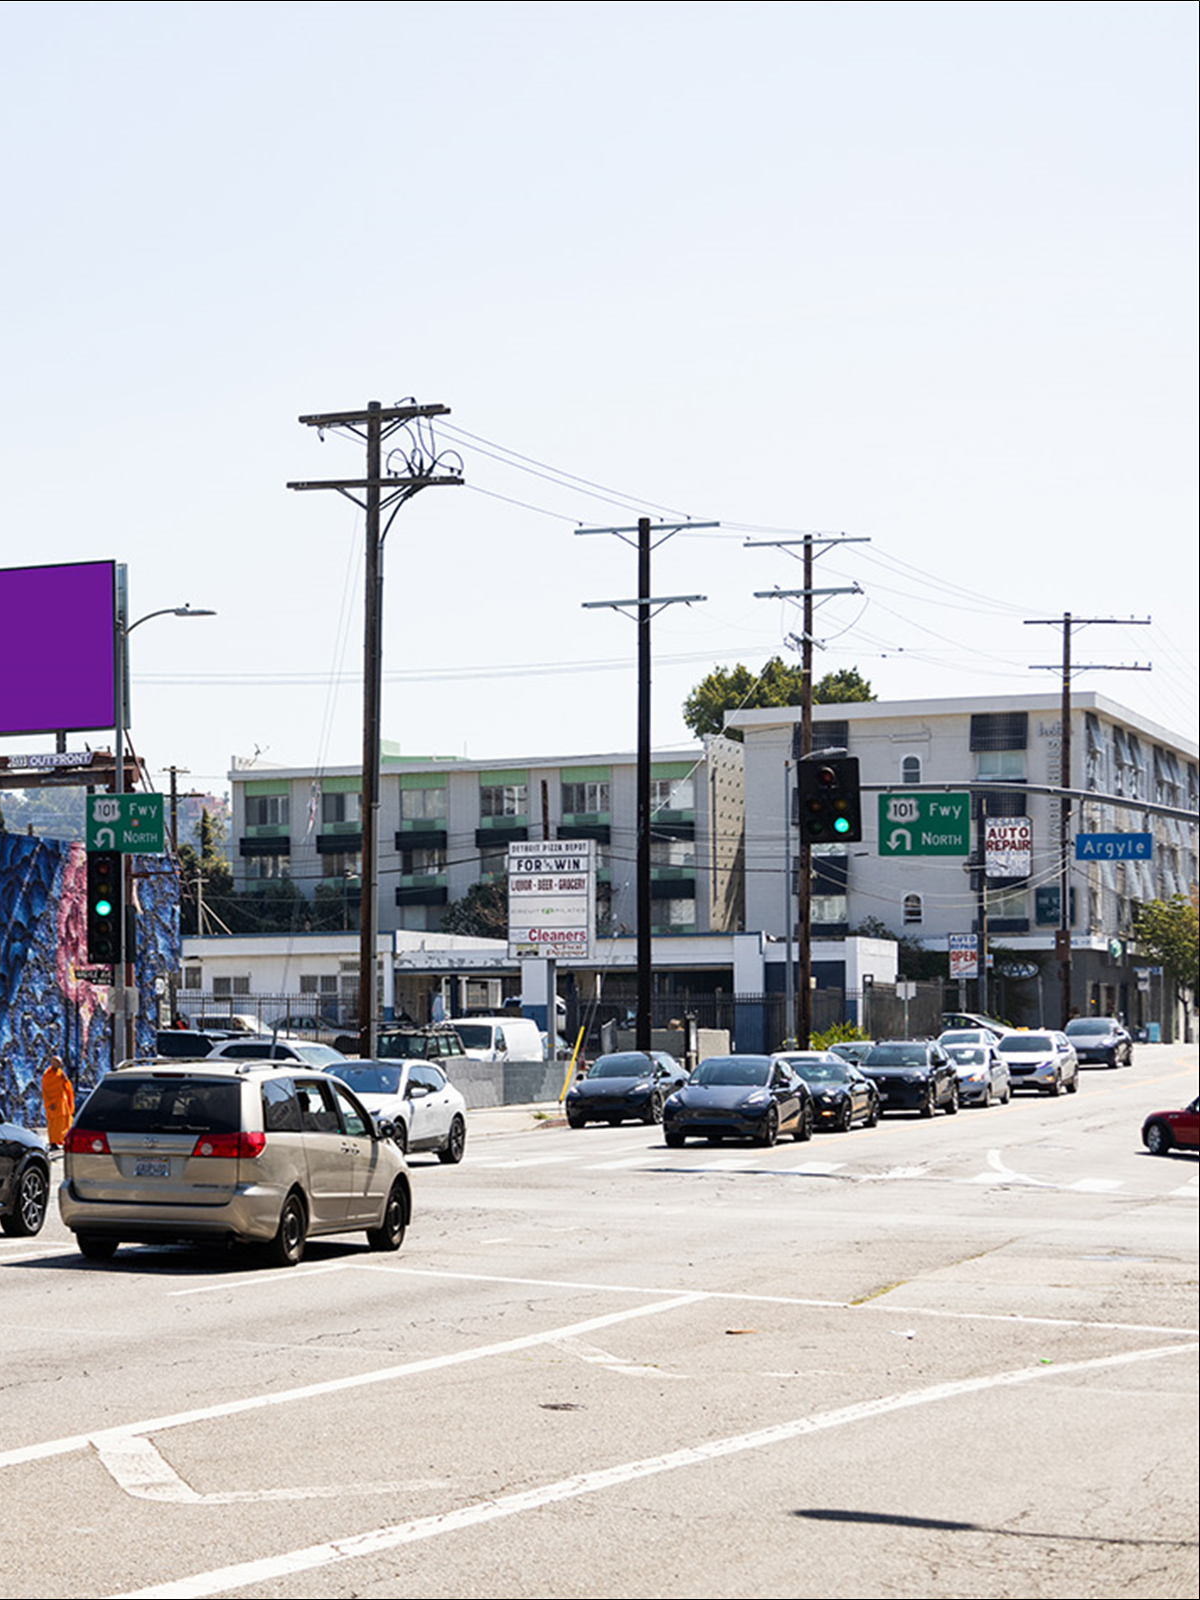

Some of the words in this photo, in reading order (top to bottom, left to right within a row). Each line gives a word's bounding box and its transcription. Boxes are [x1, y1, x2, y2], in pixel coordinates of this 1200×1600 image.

[29, 752, 91, 767] OUTFRONT
[97, 804, 116, 817] 101
[129, 802, 158, 819] Fwy
[893, 803, 914, 817] 101
[929, 802, 962, 820] Fwy
[122, 830, 158, 844] NORTH
[921, 832, 962, 846] NORTH
[987, 827, 1029, 839] AUTO
[511, 844, 541, 854] DETROIT
[542, 844, 563, 852] PIZZA
[564, 843, 586, 852] DEPOT
[986, 839, 1031, 851] REPAIR
[1082, 840, 1145, 858] Argyle
[517, 859, 542, 871] FOR
[554, 858, 580, 870] WIN
[511, 879, 533, 892] LIQUOR
[537, 878, 554, 891] BEER
[558, 878, 586, 890] GROCERY
[528, 928, 587, 942] Cleaners
[951, 935, 976, 943] AUTO
[950, 951, 978, 962] OPEN
